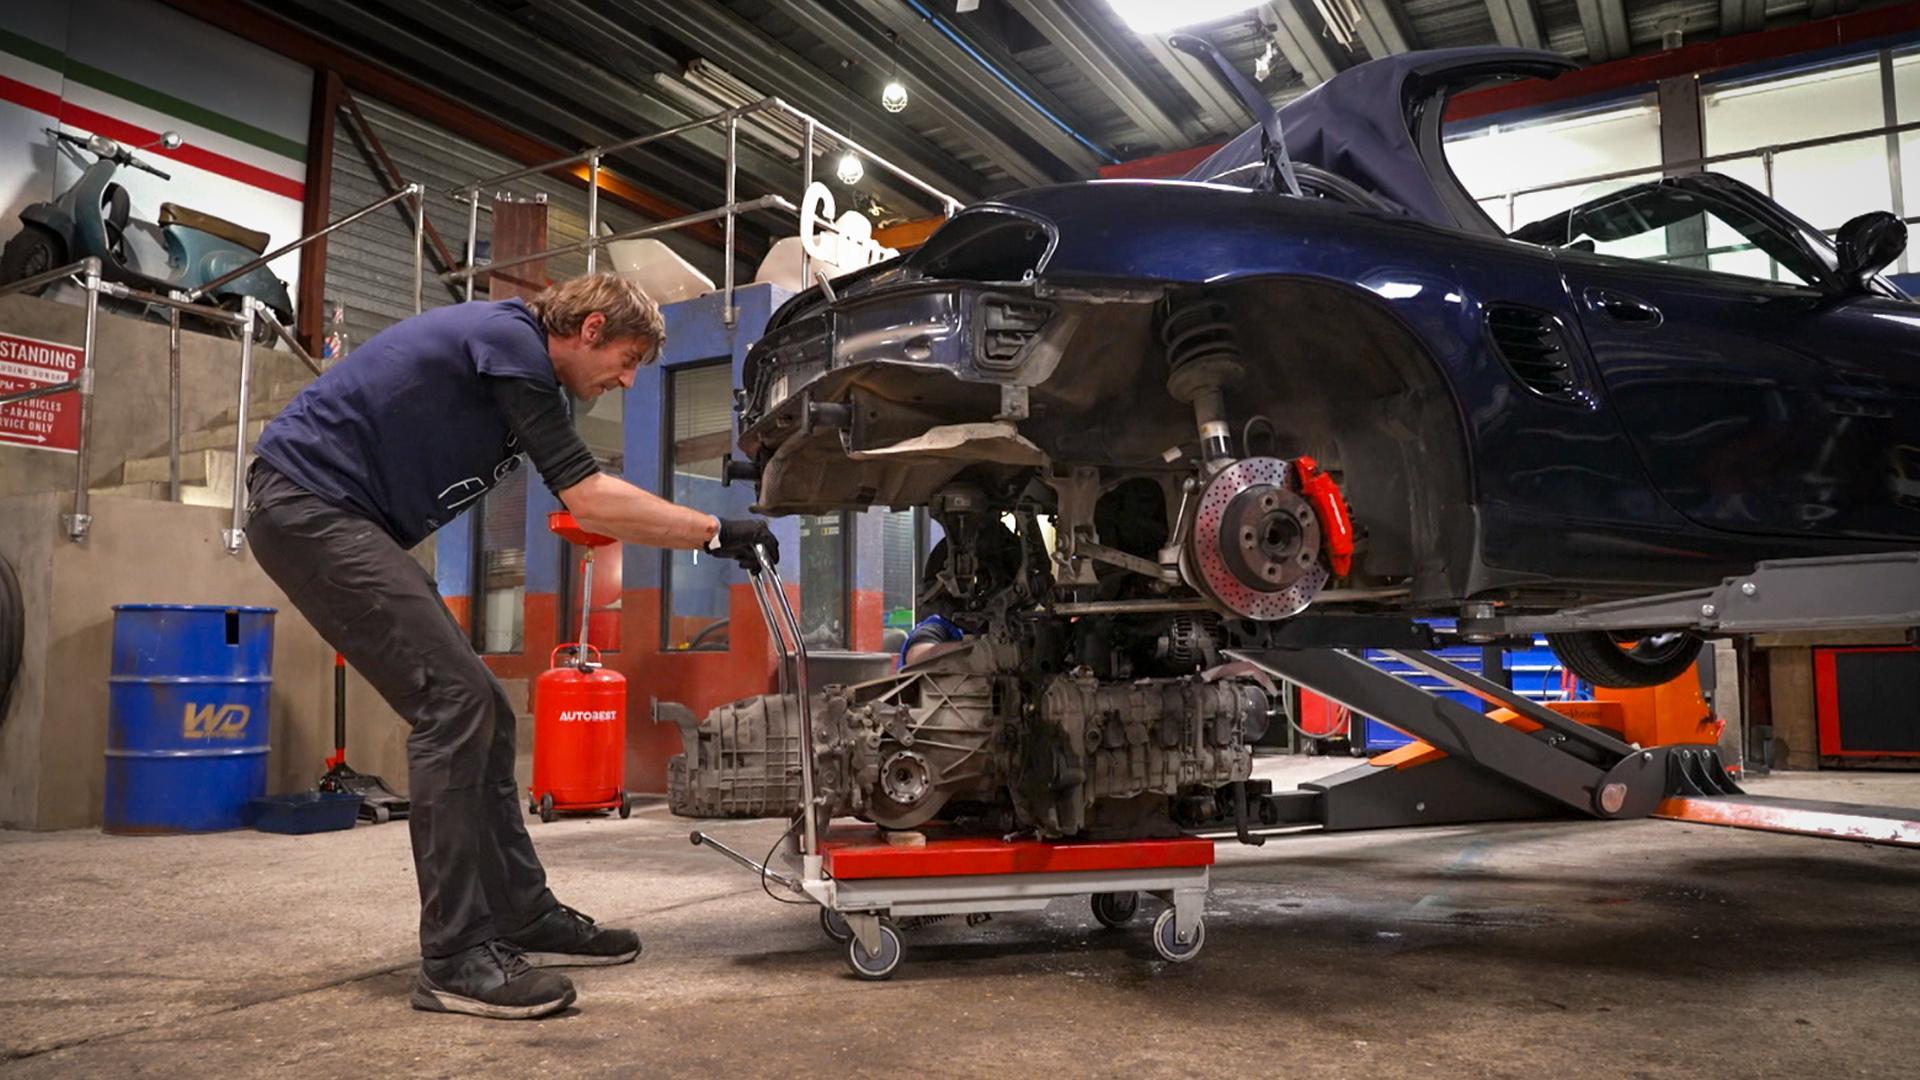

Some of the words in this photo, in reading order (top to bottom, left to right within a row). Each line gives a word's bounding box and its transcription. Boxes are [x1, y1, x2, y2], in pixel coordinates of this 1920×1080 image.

[0, 341, 76, 369] STANDING
[28, 420, 53, 434] ONLY
[184, 703, 250, 737] WD
[559, 710, 617, 722] AUTOBEST
